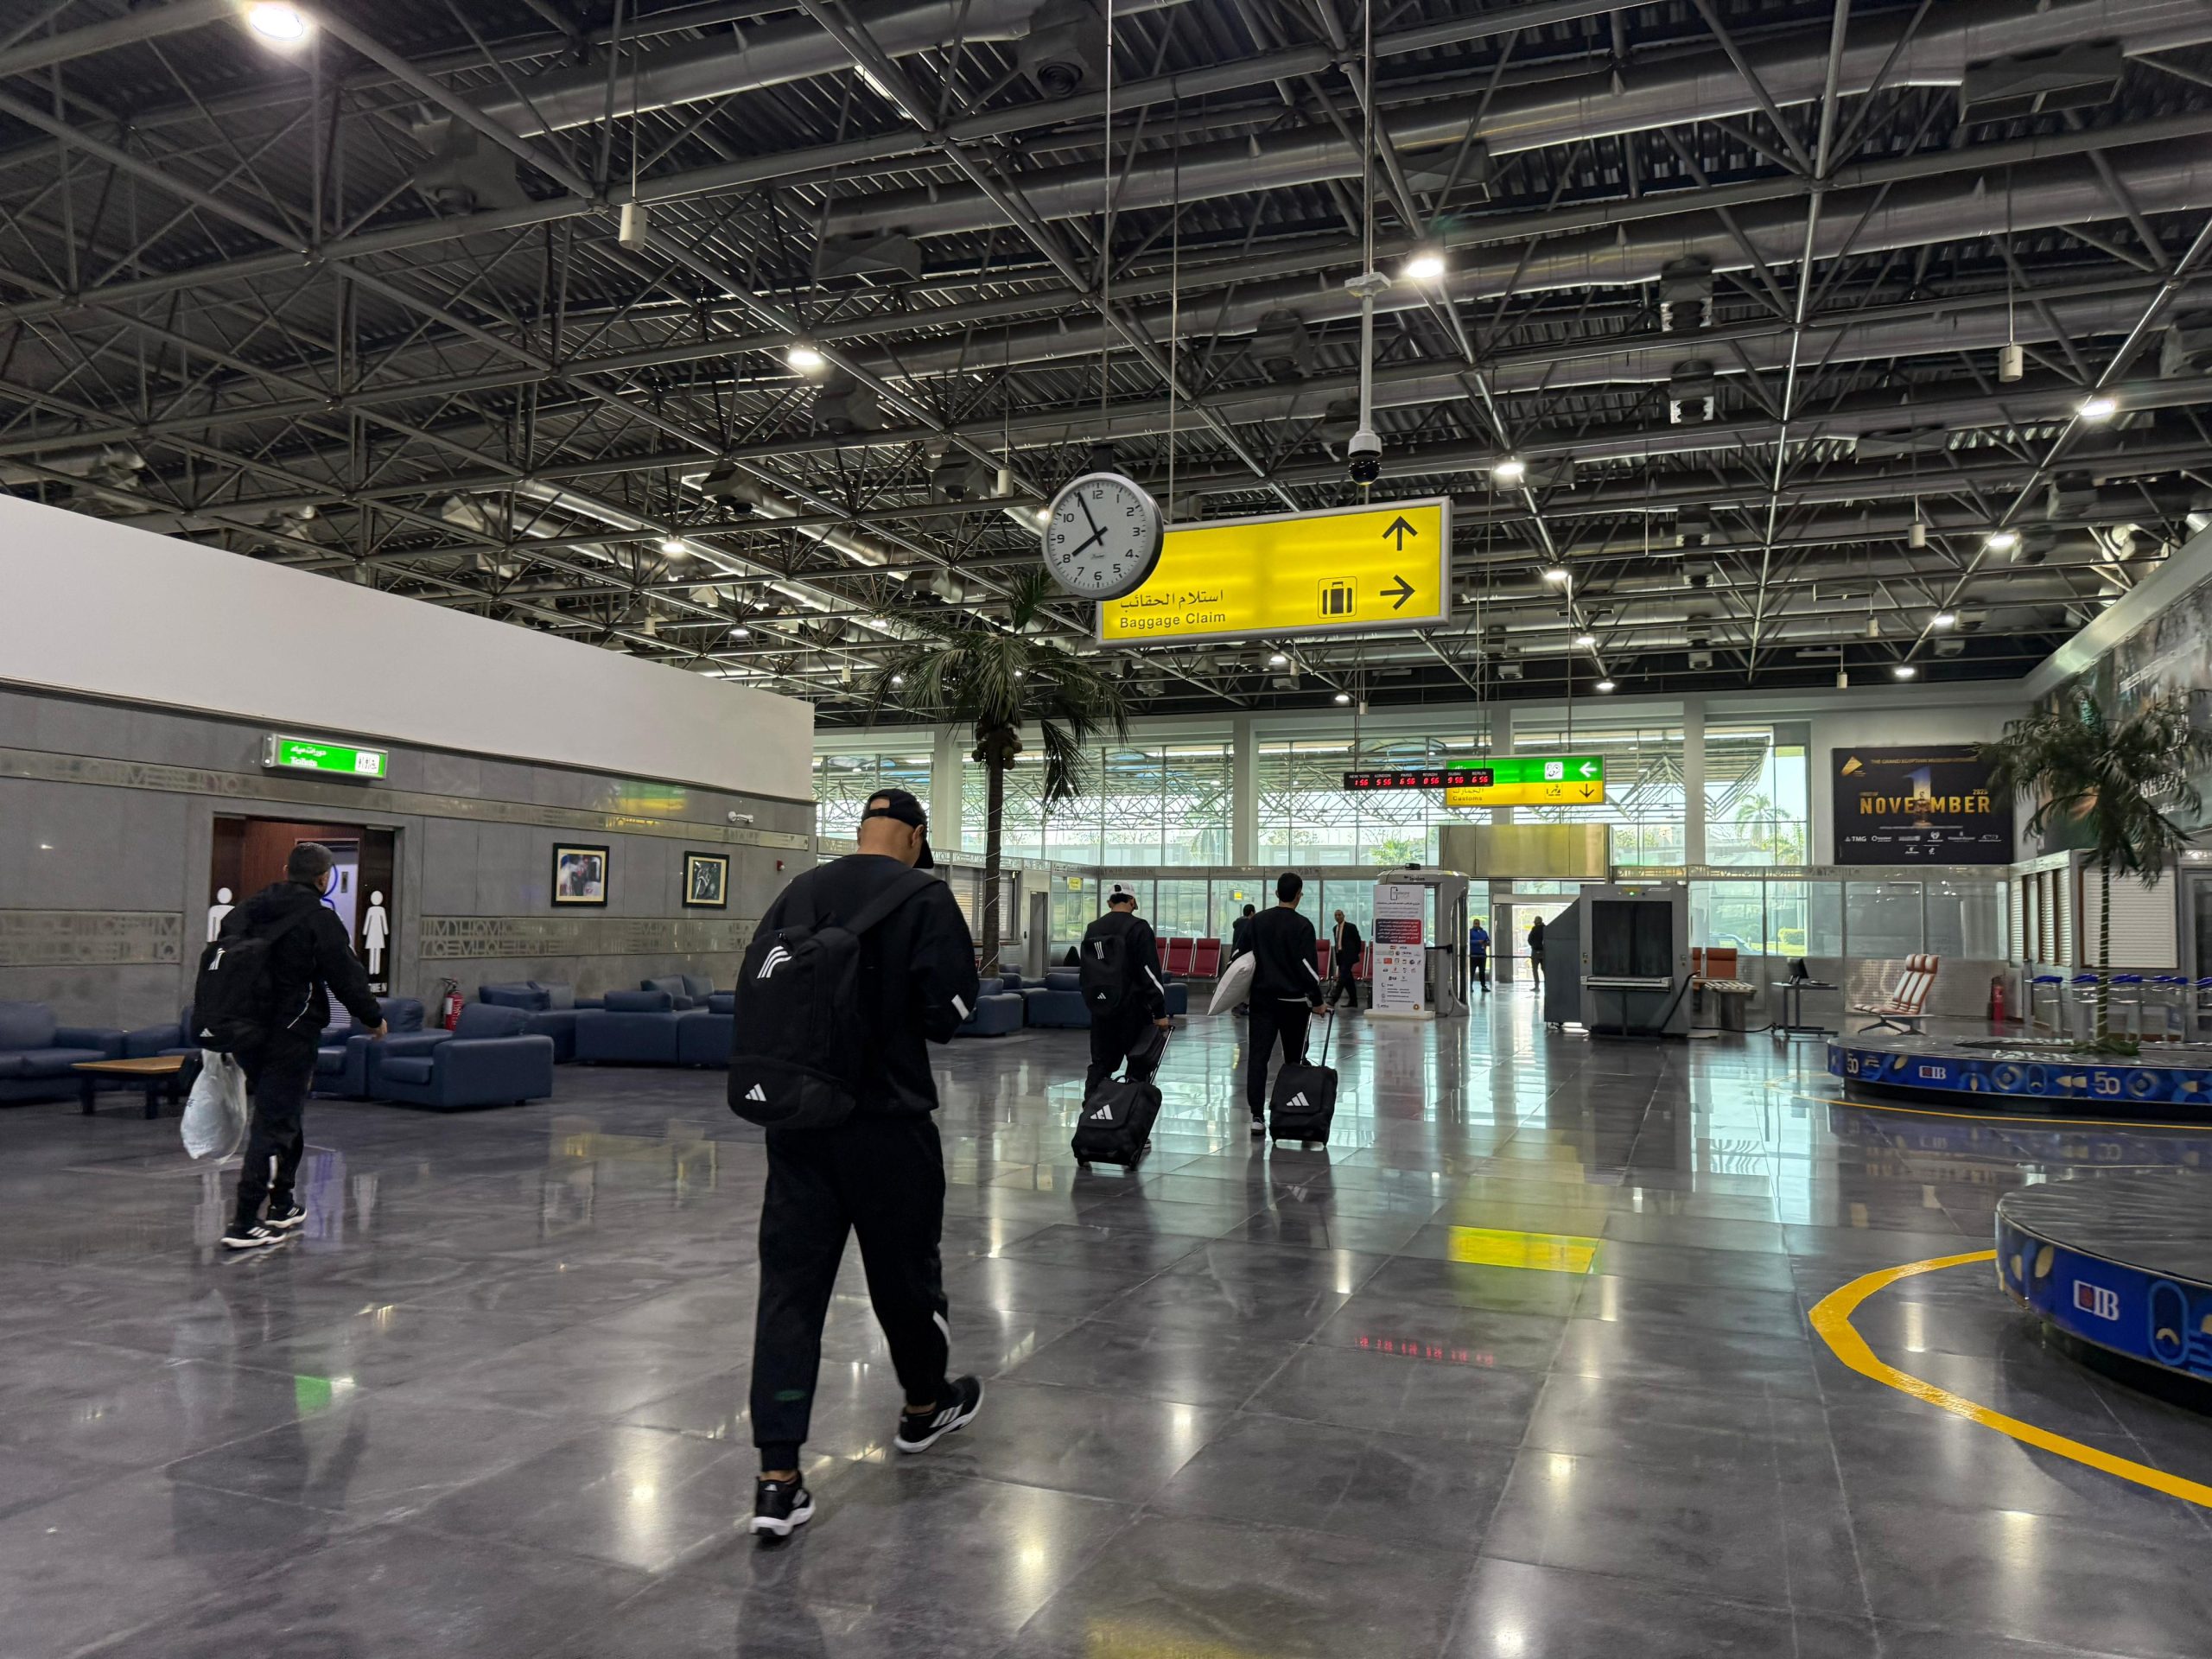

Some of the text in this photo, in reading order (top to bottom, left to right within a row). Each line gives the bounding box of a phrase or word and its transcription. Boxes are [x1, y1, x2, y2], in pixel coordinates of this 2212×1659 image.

[1092, 490, 1103, 499] 12
[1126, 507, 1135, 517] 2
[1063, 513, 1074, 523] 10
[1132, 527, 1141, 537] 3
[1057, 534, 1065, 543] 9
[1063, 554, 1071, 563] 8
[1125, 549, 1134, 558] 4
[1077, 567, 1084, 576] 7
[1113, 563, 1121, 573] 5
[1094, 571, 1102, 581] 6
[1120, 589, 1224, 613] استلام الحقائب
[1120, 612, 1225, 629] Baggage Claim
[1860, 796, 1991, 814] NOVEMBER
[2094, 1071, 2121, 1095] 50
